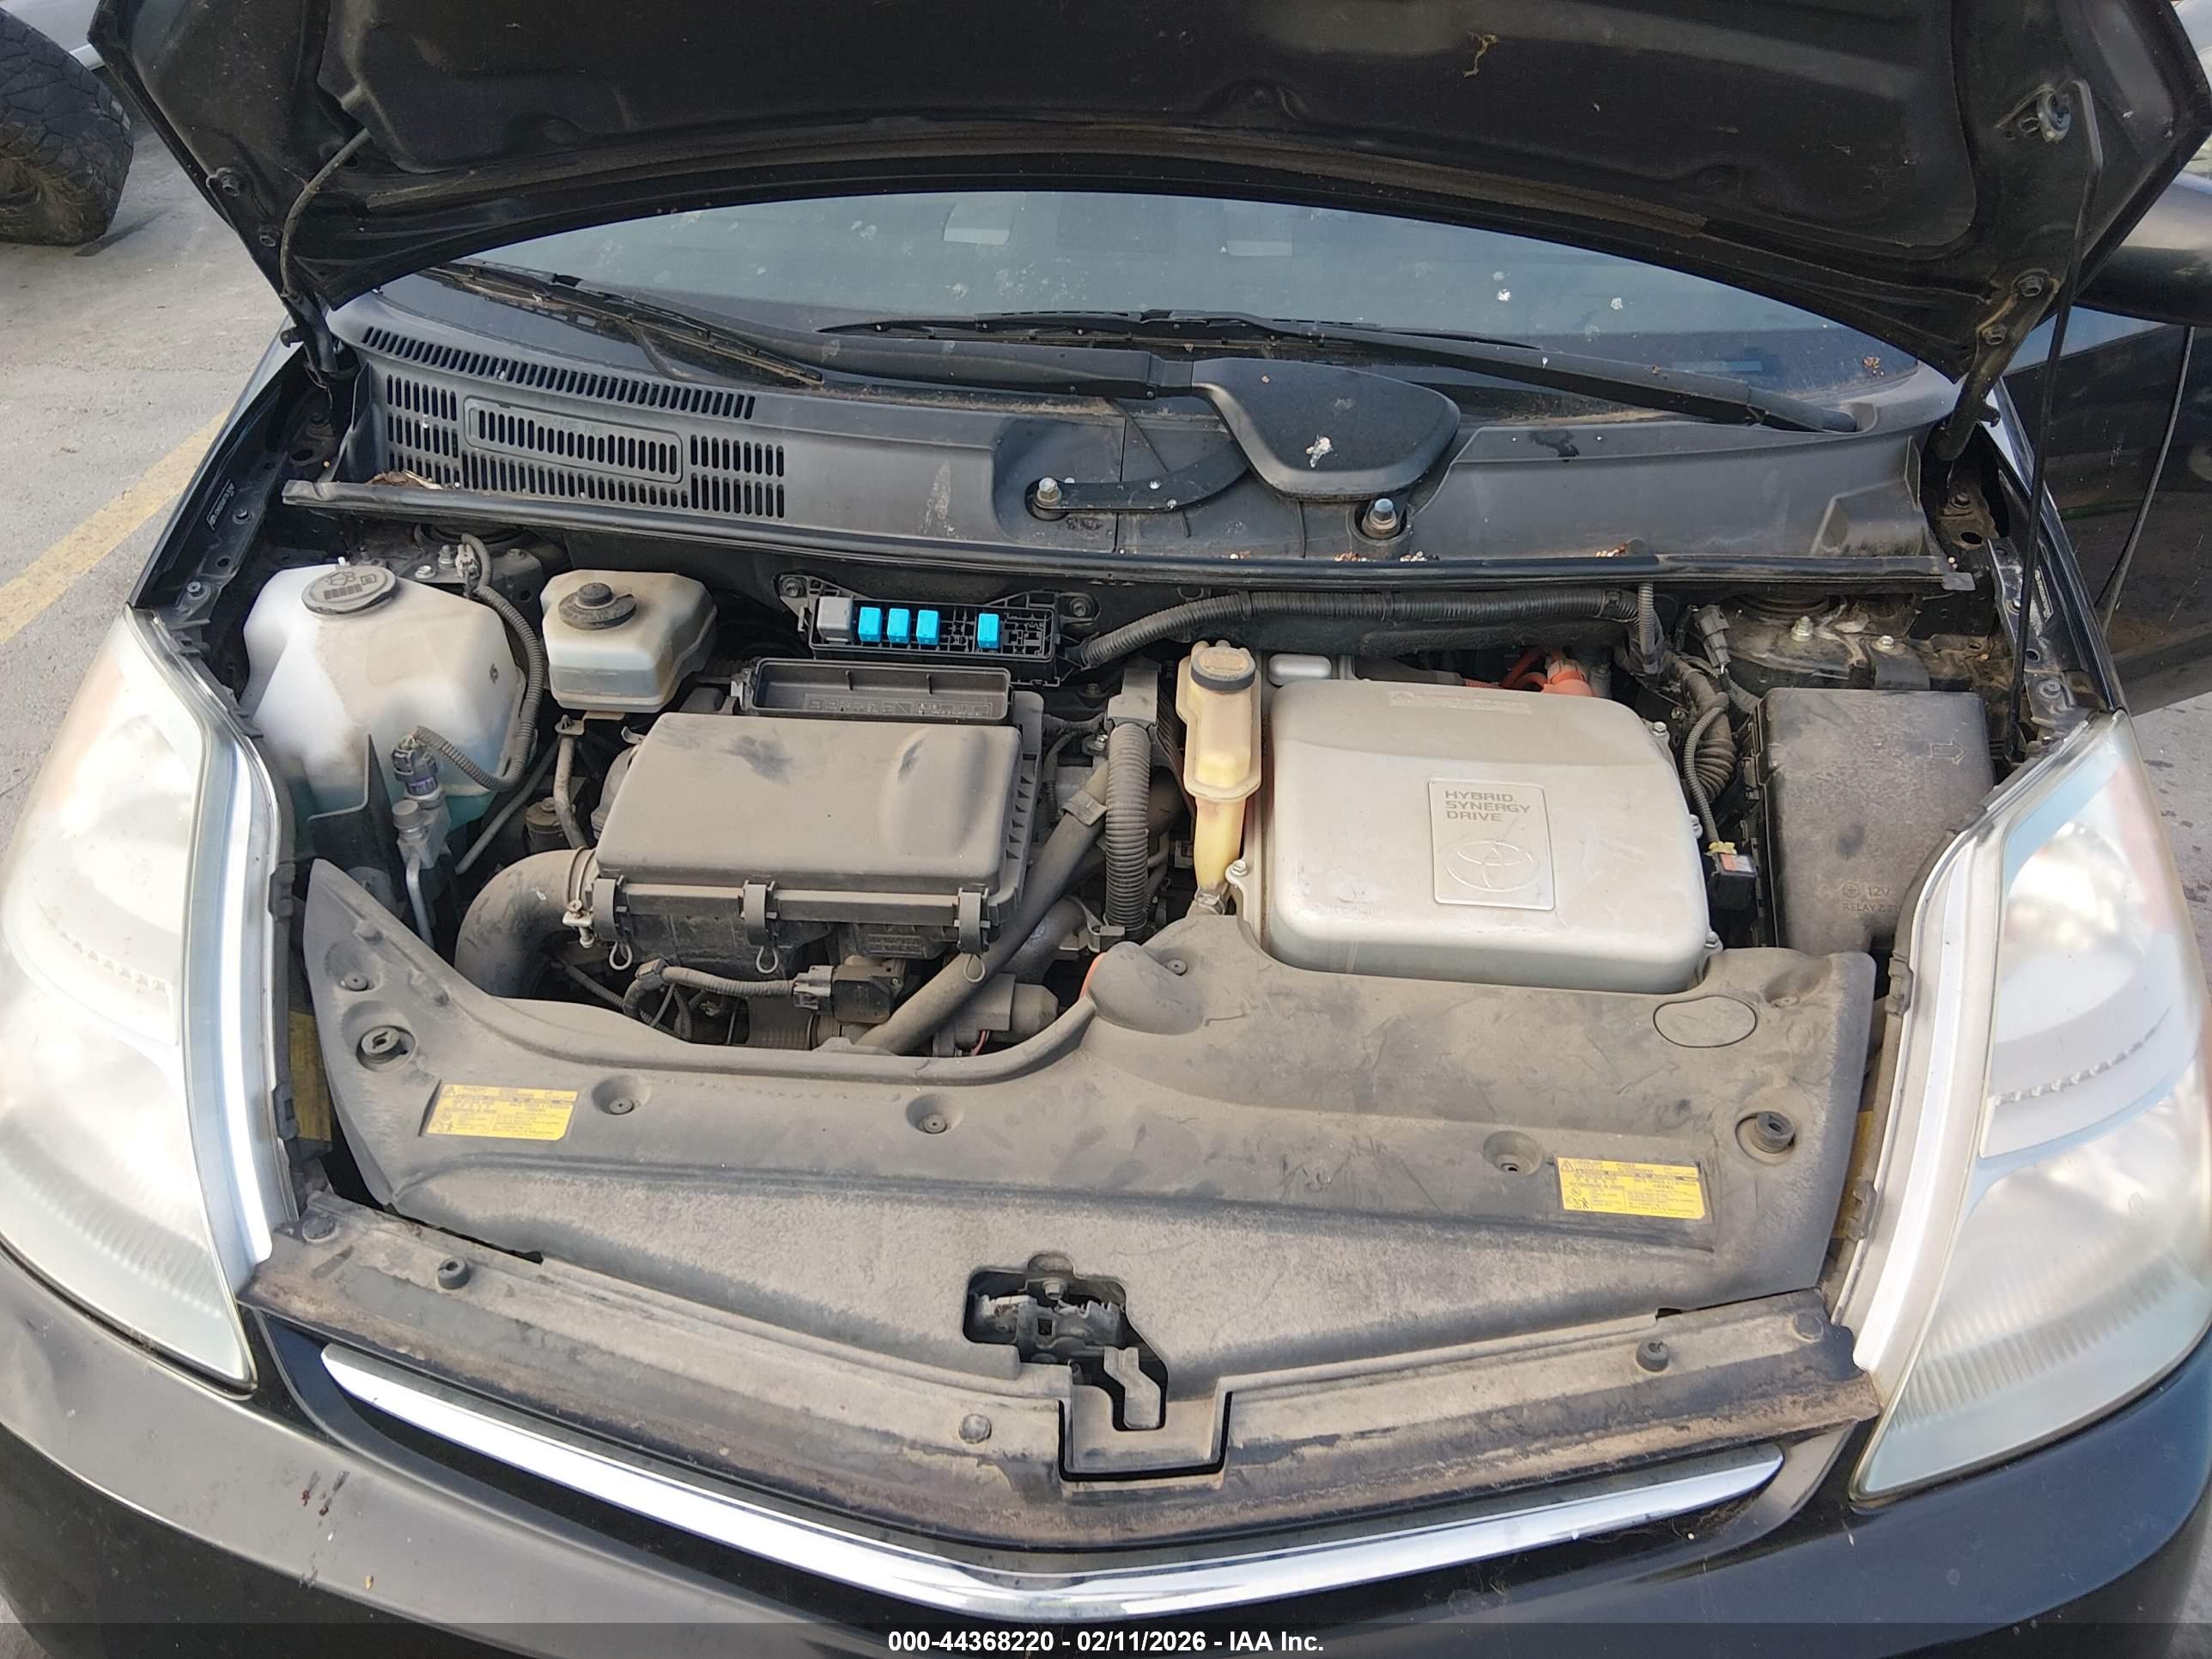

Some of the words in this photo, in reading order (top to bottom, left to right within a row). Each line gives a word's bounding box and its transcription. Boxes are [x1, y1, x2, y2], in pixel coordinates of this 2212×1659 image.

[1444, 790, 1514, 803] HYBRID
[1445, 800, 1532, 813] SYNERGY
[1446, 811, 1502, 822] DRIVE
[1868, 885, 1891, 897] 12V
[1842, 902, 1876, 913] RELAY
